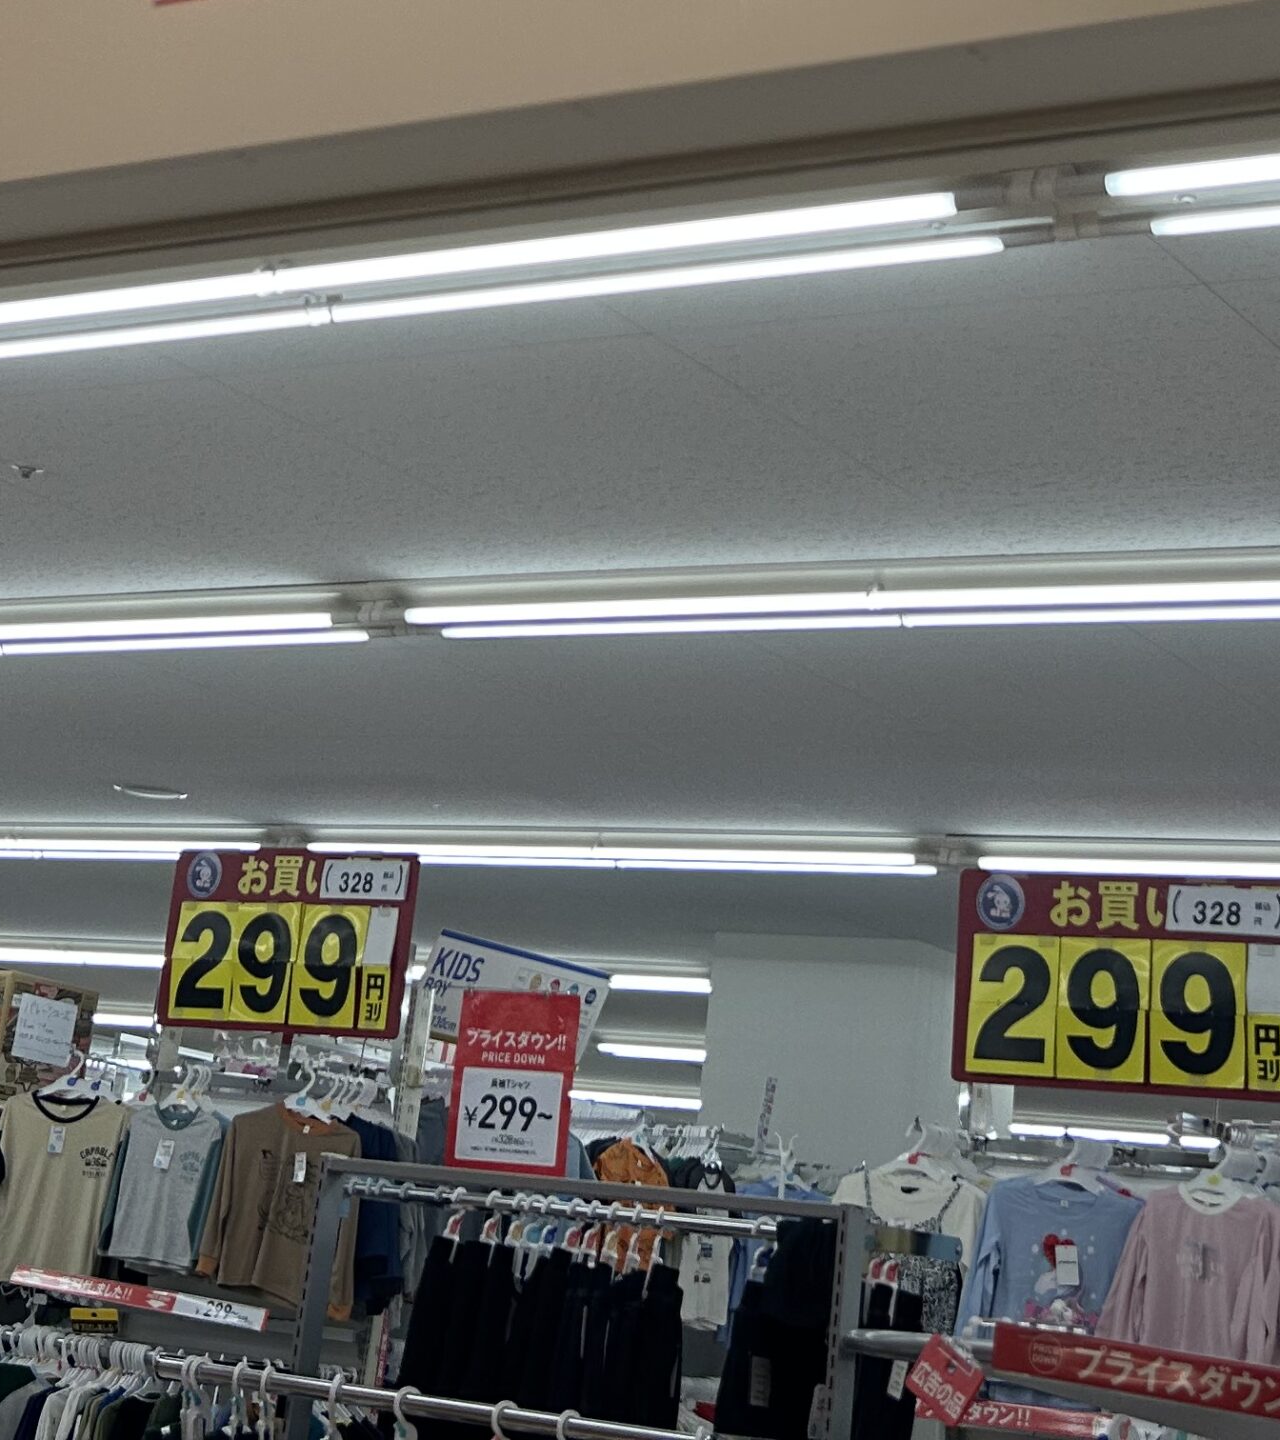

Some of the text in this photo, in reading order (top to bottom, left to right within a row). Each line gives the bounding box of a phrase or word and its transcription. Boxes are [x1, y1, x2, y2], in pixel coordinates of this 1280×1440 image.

[174, 910, 357, 1017] 299
[431, 946, 485, 982] KIDS
[973, 944, 1236, 1076] 299
[482, 1051, 545, 1065] PRICE DOWN
[910, 1360, 967, 1420] 広告の品
